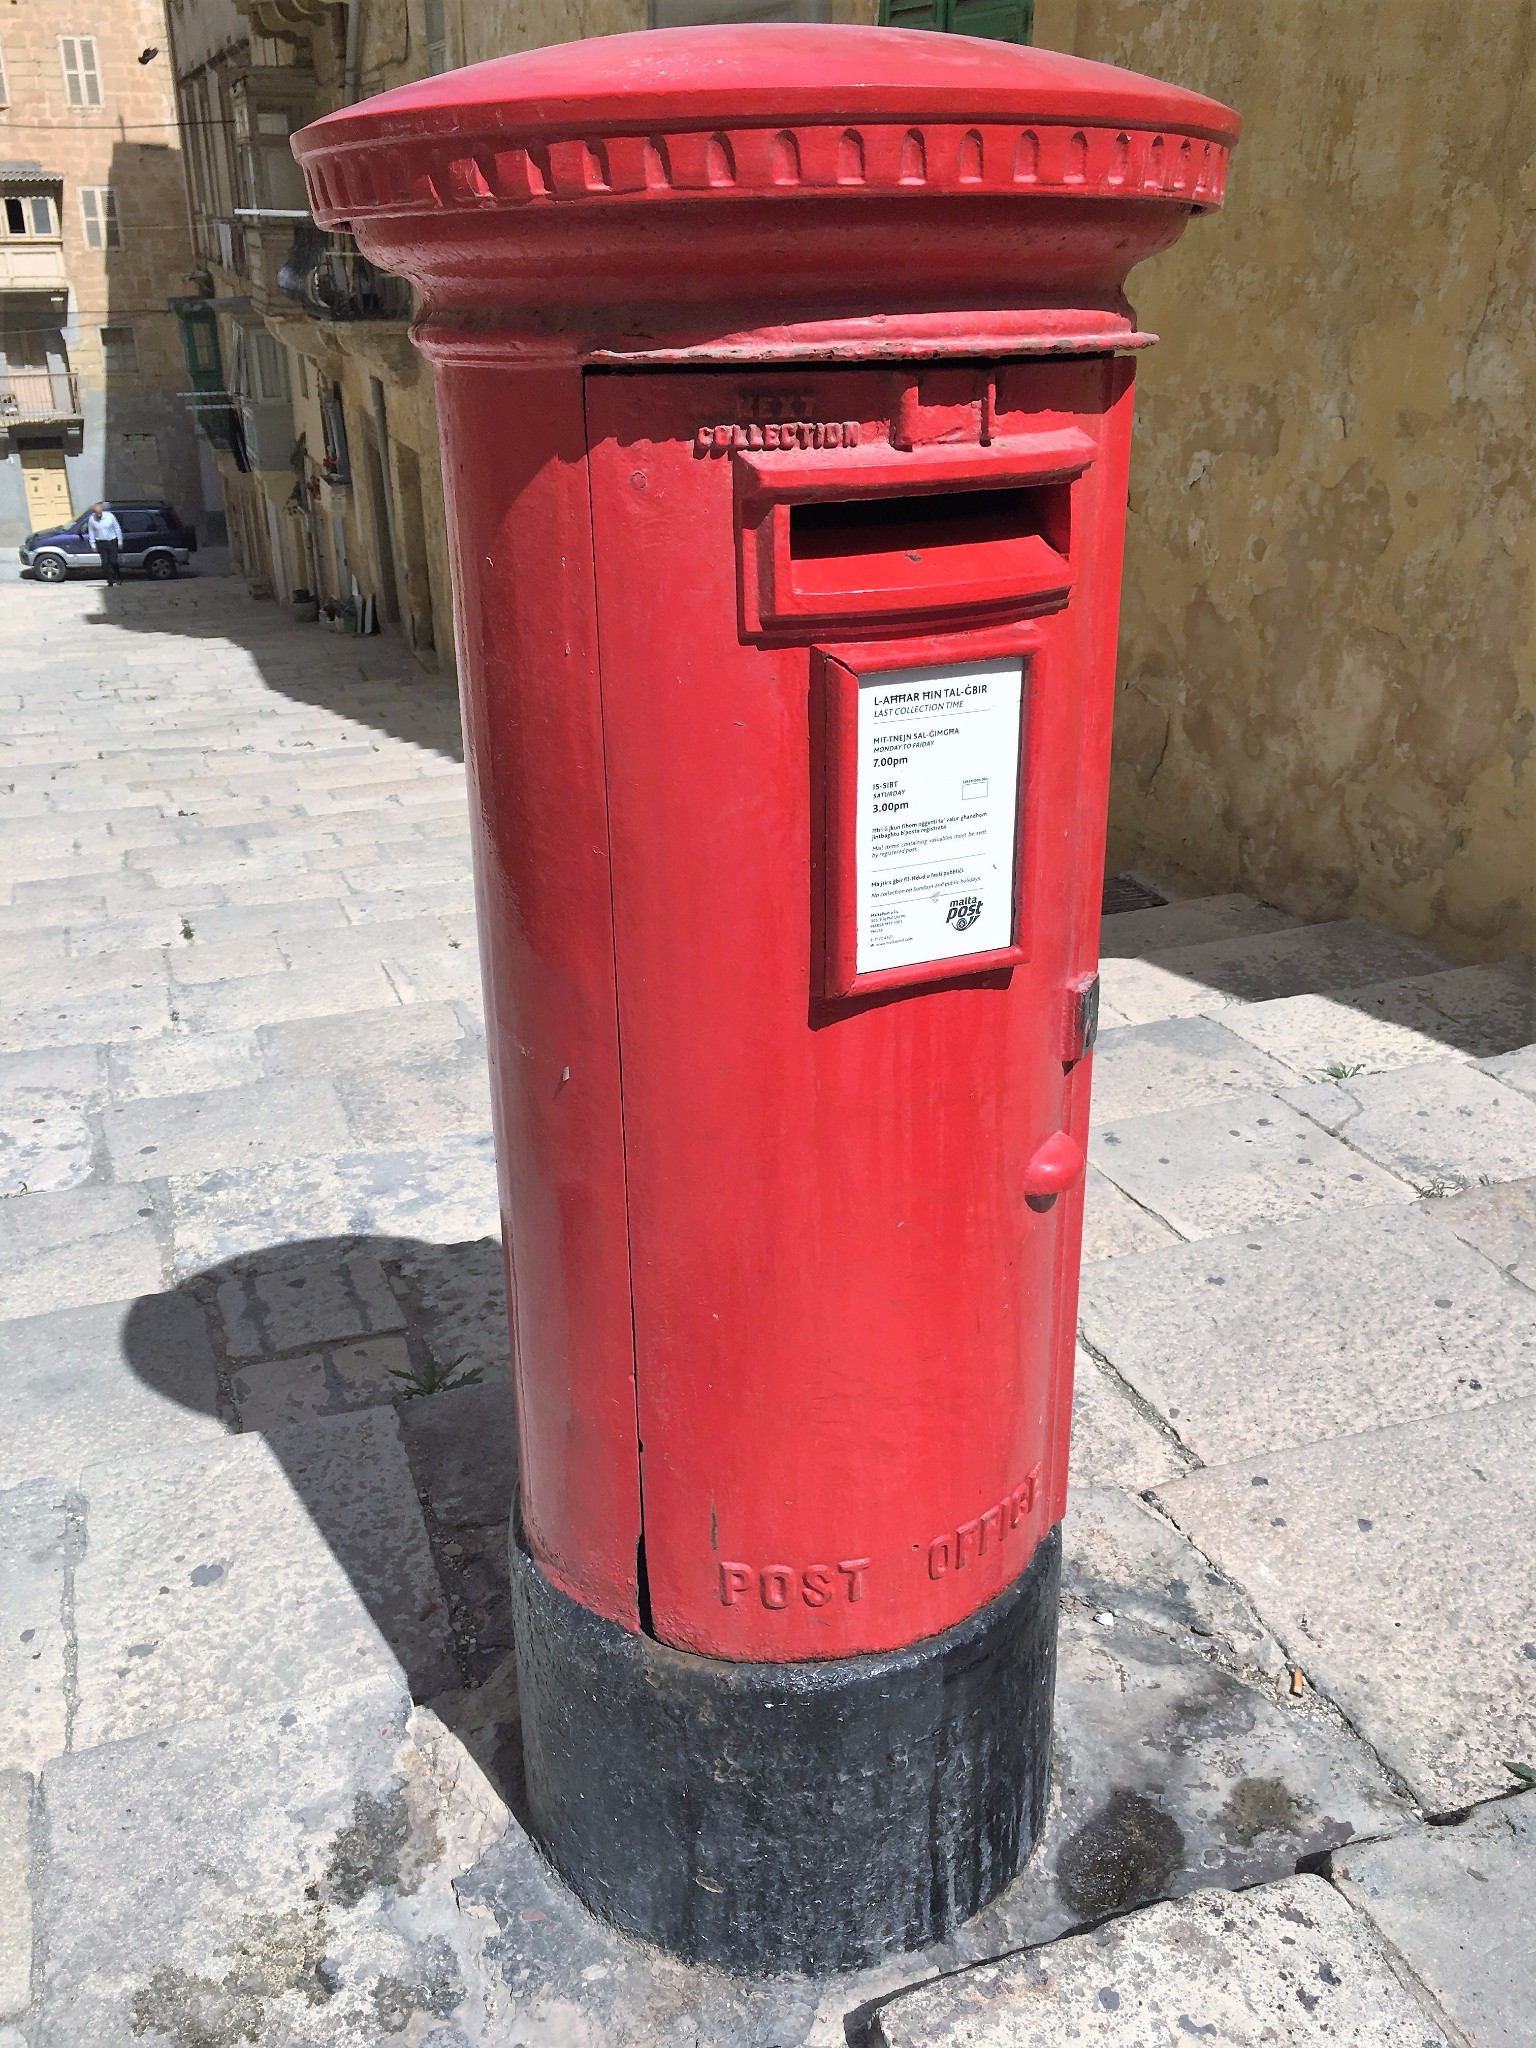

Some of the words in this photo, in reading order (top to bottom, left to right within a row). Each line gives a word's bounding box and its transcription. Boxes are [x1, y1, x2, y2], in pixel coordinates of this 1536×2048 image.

[697, 421, 862, 451] COLLECTION
[874, 708, 893, 718] LAST
[894, 702, 945, 716] COLLECTION
[945, 700, 964, 710] TIME
[873, 744, 902, 753] MONDAY
[912, 740, 935, 749] FRIDAY
[873, 756, 908, 769] 7.00pm
[872, 780, 899, 791] IS-SIBT
[872, 789, 906, 799] SATURDAY
[872, 801, 909, 814] 3.00pm
[949, 896, 978, 908] malta
[945, 900, 984, 924] post
[718, 1557, 871, 1610] POST
